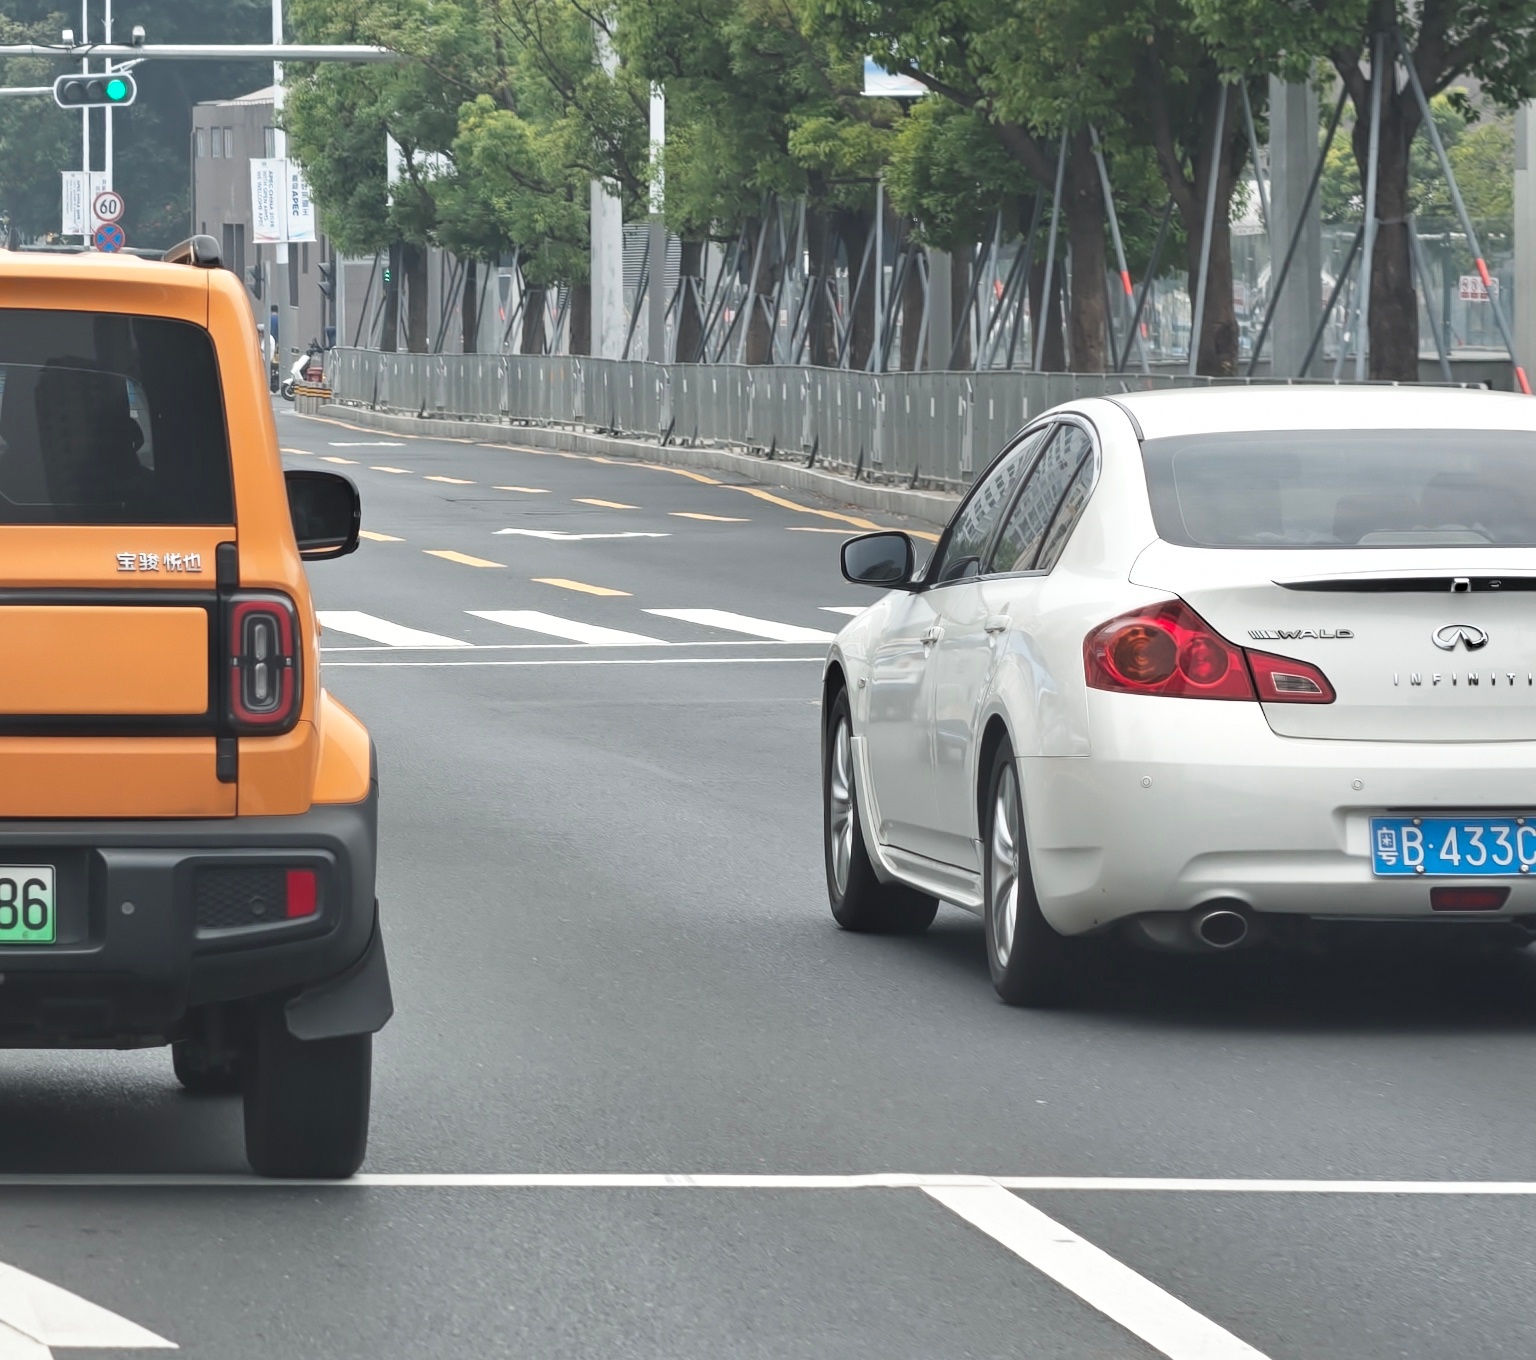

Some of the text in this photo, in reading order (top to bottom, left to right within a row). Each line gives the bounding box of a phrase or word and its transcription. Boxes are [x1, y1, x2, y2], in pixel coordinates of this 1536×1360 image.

[100, 199, 117, 215] 60
[1278, 629, 1355, 640] WALD
[1394, 673, 1533, 686] INFINITI
